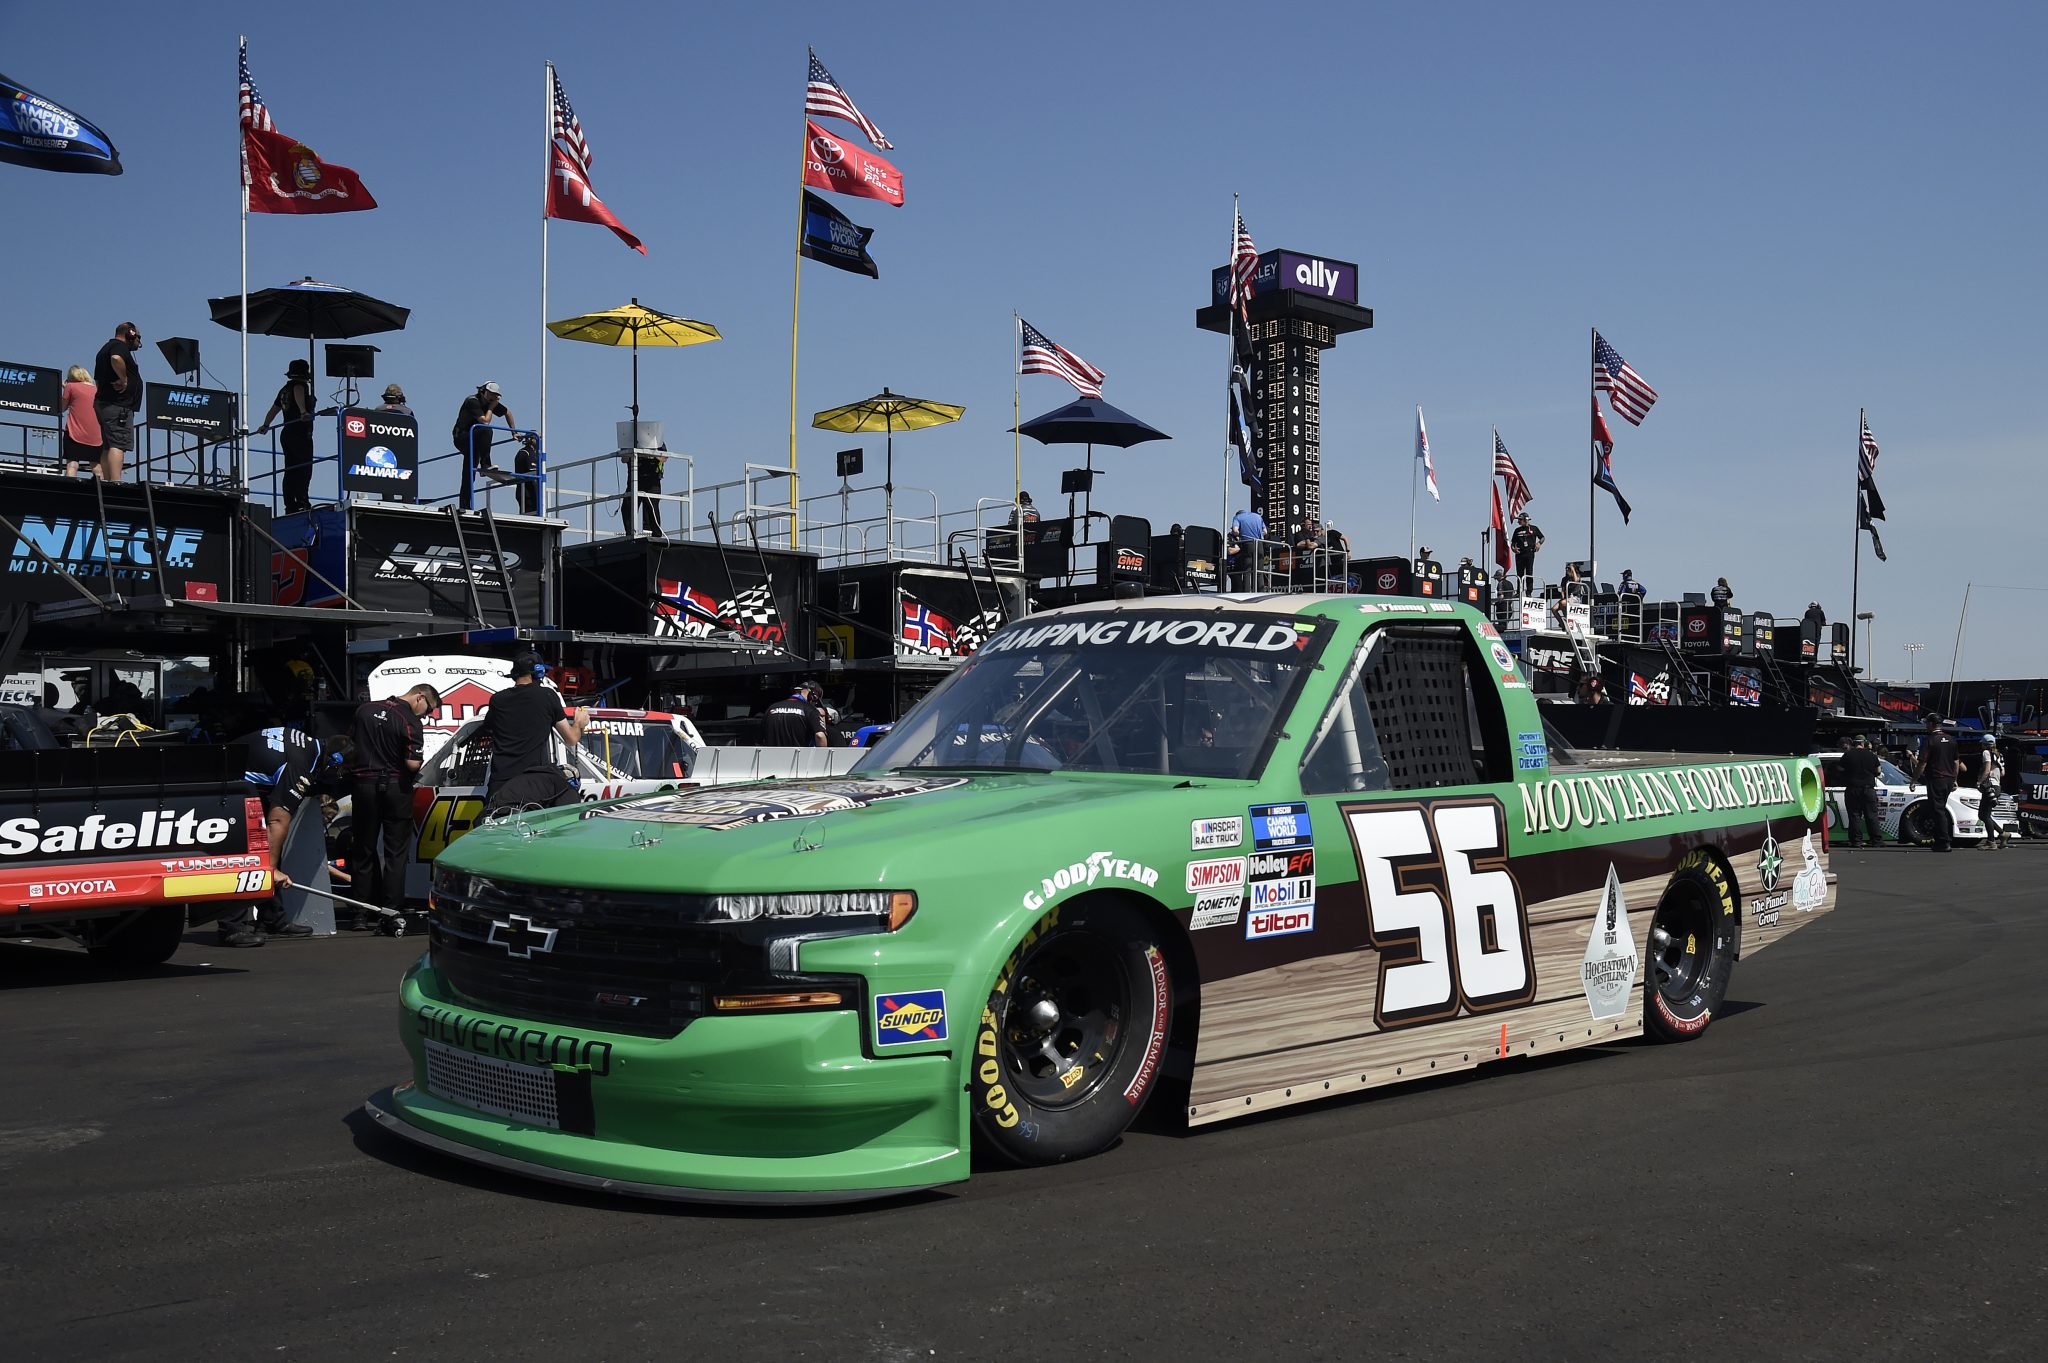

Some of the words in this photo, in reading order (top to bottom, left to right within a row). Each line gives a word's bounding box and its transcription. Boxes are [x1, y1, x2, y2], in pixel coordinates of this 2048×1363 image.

[12, 101, 80, 130] CAMPING
[30, 97, 76, 120] NASCAR
[16, 115, 79, 138] WORLD
[806, 160, 848, 179] TOYOTA
[1295, 259, 1340, 297] ally
[1256, 370, 1264, 381] 2
[1292, 366, 1299, 377] 2
[168, 390, 211, 406] NIECE
[1256, 389, 1264, 400] 3
[1292, 386, 1299, 397] 3
[0, 400, 51, 412] CHEVROLET
[1256, 408, 1264, 419] 4
[1292, 405, 1300, 416] 4
[175, 416, 221, 426] CHEVROLET
[369, 423, 415, 438] TOYOTA
[1292, 425, 1299, 436] 5
[1256, 448, 1264, 459] 6
[1292, 445, 1300, 456] 6
[355, 465, 399, 479] HALMAR
[1292, 465, 1299, 476] 7
[1292, 484, 1300, 495] 8
[1292, 504, 1300, 515] 9
[12, 514, 205, 569] NIECE
[1118, 555, 1143, 566] GMS
[472, 579, 508, 587] RACIN
[1523, 600, 1546, 611] HRE
[1569, 605, 1590, 616] HRE
[978, 619, 1129, 657] CAMPING
[1127, 620, 1299, 652] WORLD
[1684, 640, 1711, 648] TOYOTA
[1519, 757, 1544, 769] DIECAST
[1517, 771, 1683, 834] MOUNTAIN
[1670, 766, 1743, 812] FORK
[1738, 762, 1796, 806] BEER
[1207, 820, 1236, 833] NASCAR
[1266, 815, 1296, 826] CAMPING
[0, 809, 230, 855] Safelite
[1195, 836, 1214, 845] RACE
[1216, 833, 1239, 843] TRUCK
[1267, 825, 1298, 837] WORLD
[160, 856, 261, 873] TUNDRA
[1250, 854, 1288, 878] Holley
[235, 870, 266, 894] 18
[1191, 862, 1242, 887] SIMPSON
[45, 879, 117, 897] TOYOTA
[1022, 857, 1159, 911] GOODYEAR
[1254, 881, 1295, 904] Mobil
[1196, 895, 1240, 912] COMETIC
[1347, 803, 1529, 1016] 56
[1751, 899, 1764, 914] The
[1765, 891, 1788, 909] Pinnell
[1251, 913, 1310, 934] tilton
[1758, 911, 1779, 927] Group
[1584, 954, 1636, 981] HOCHATOWN
[1153, 960, 1167, 1011] HONOR
[1592, 971, 1629, 987] DISTILLING
[880, 1007, 942, 1030] SUNOCO
[416, 1003, 614, 1078] SILVERADO
[1129, 1030, 1164, 1100] REMEMBER
